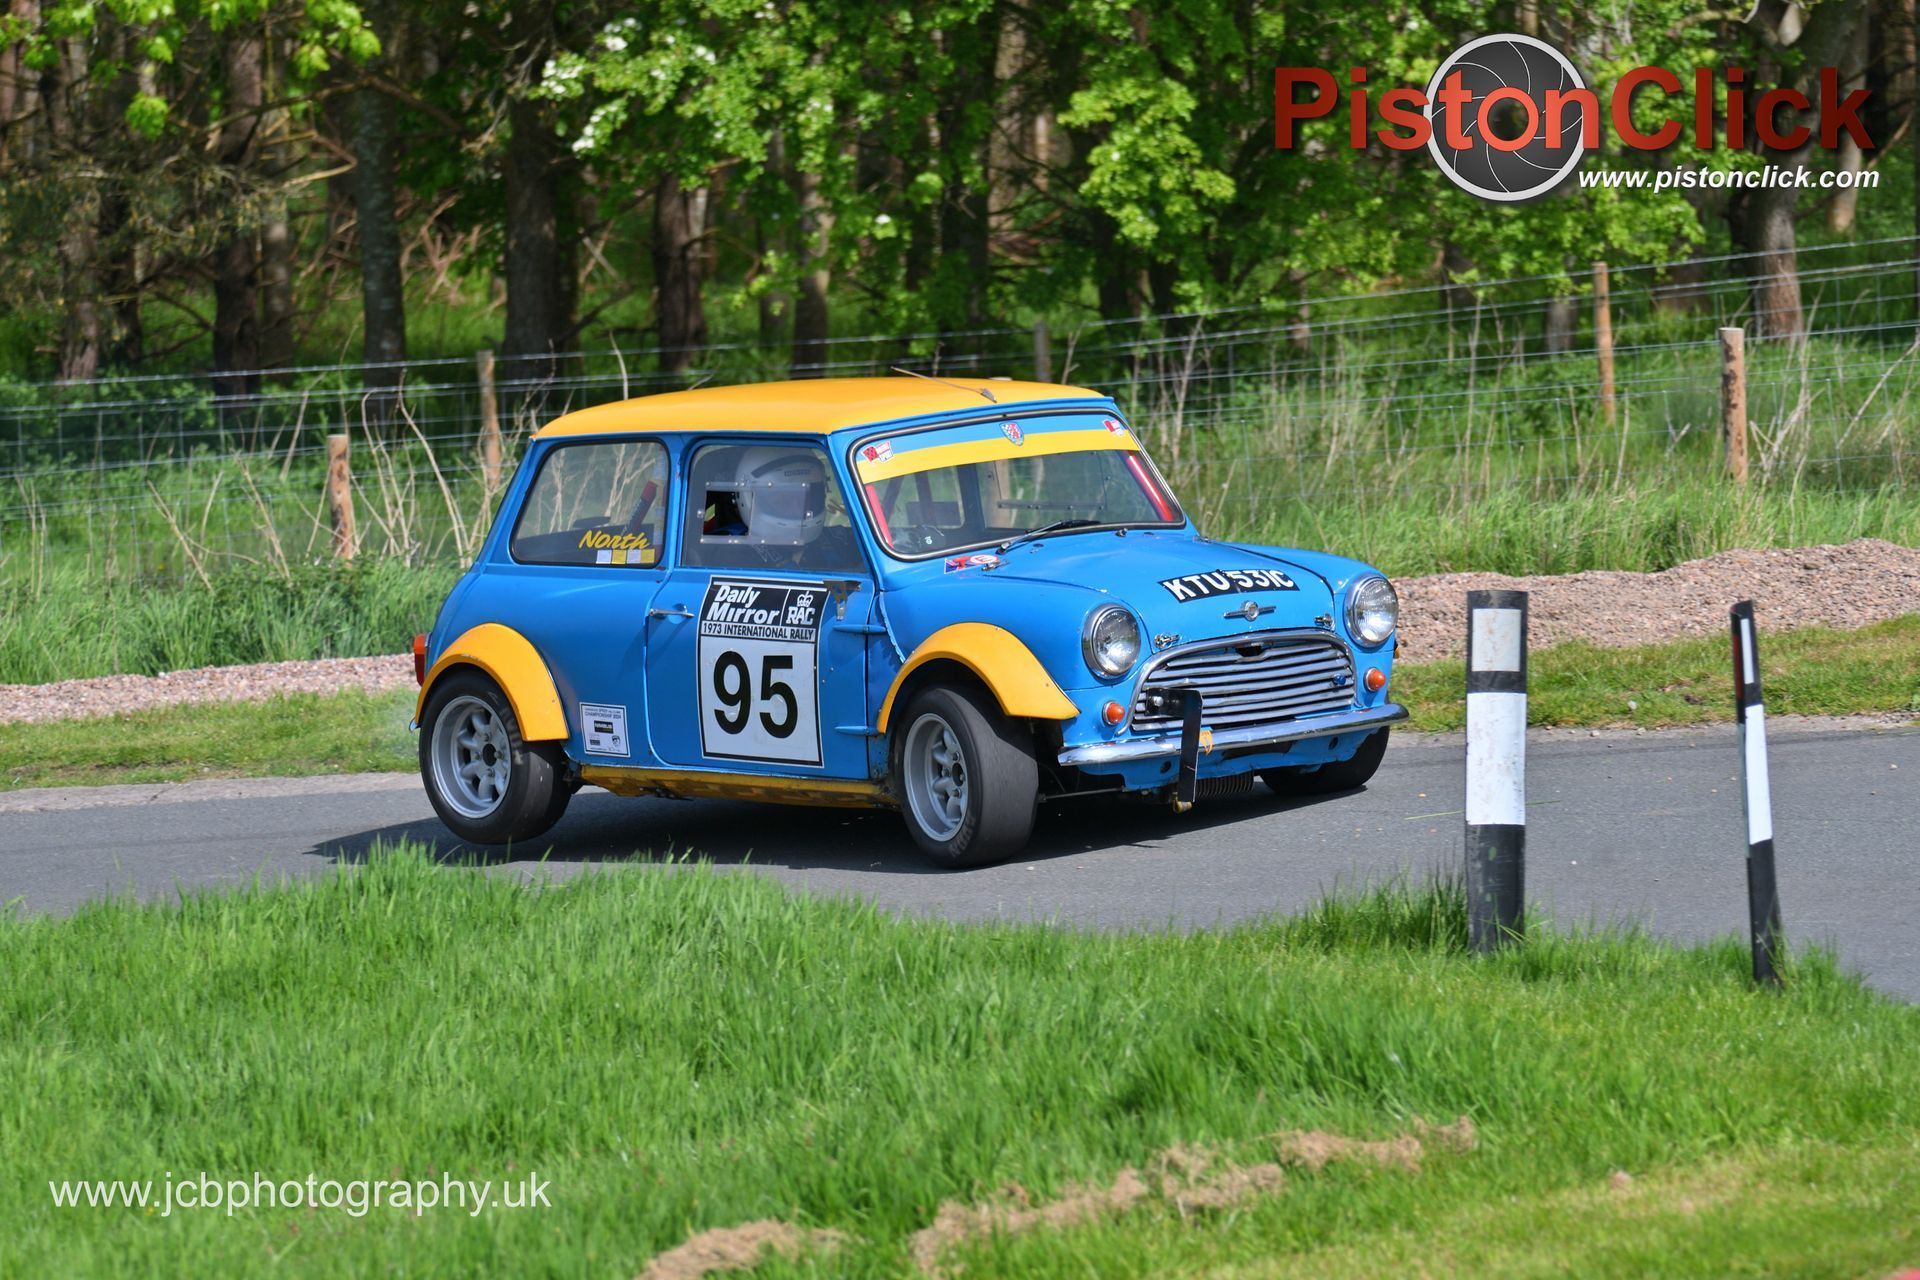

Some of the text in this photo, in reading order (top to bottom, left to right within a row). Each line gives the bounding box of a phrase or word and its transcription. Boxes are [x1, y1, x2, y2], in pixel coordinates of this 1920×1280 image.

[578, 530, 650, 549] North
[1162, 569, 1295, 601] KTU 531C
[714, 585, 760, 609] Daily
[706, 602, 780, 625] Mirror
[786, 606, 816, 626] RAC
[703, 622, 814, 641] 1973 INTERNATIONAL RALLY
[713, 650, 798, 739] 95
